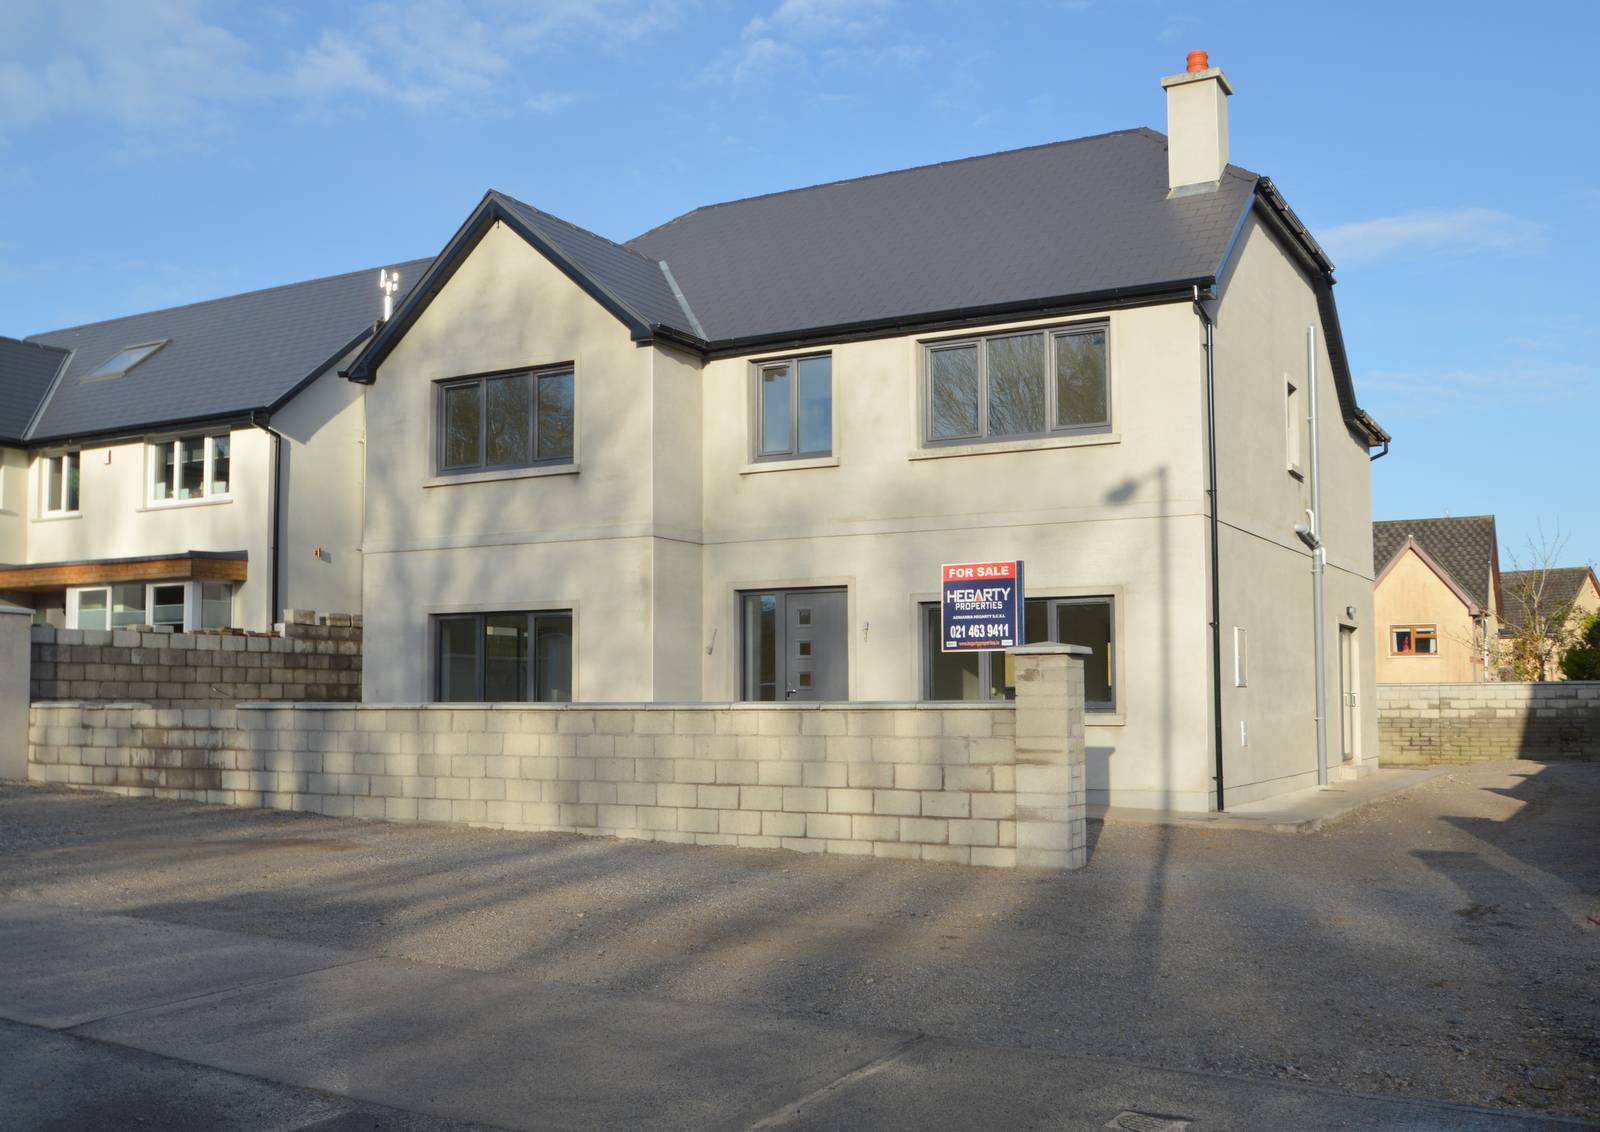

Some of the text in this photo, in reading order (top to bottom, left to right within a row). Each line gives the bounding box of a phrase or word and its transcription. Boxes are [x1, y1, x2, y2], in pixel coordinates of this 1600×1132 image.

[949, 566, 1009, 578] FOR SALE
[947, 588, 1010, 603] HEGARTY
[956, 601, 1002, 610] PROPERTIES
[951, 624, 1008, 638] 021 463 9411
